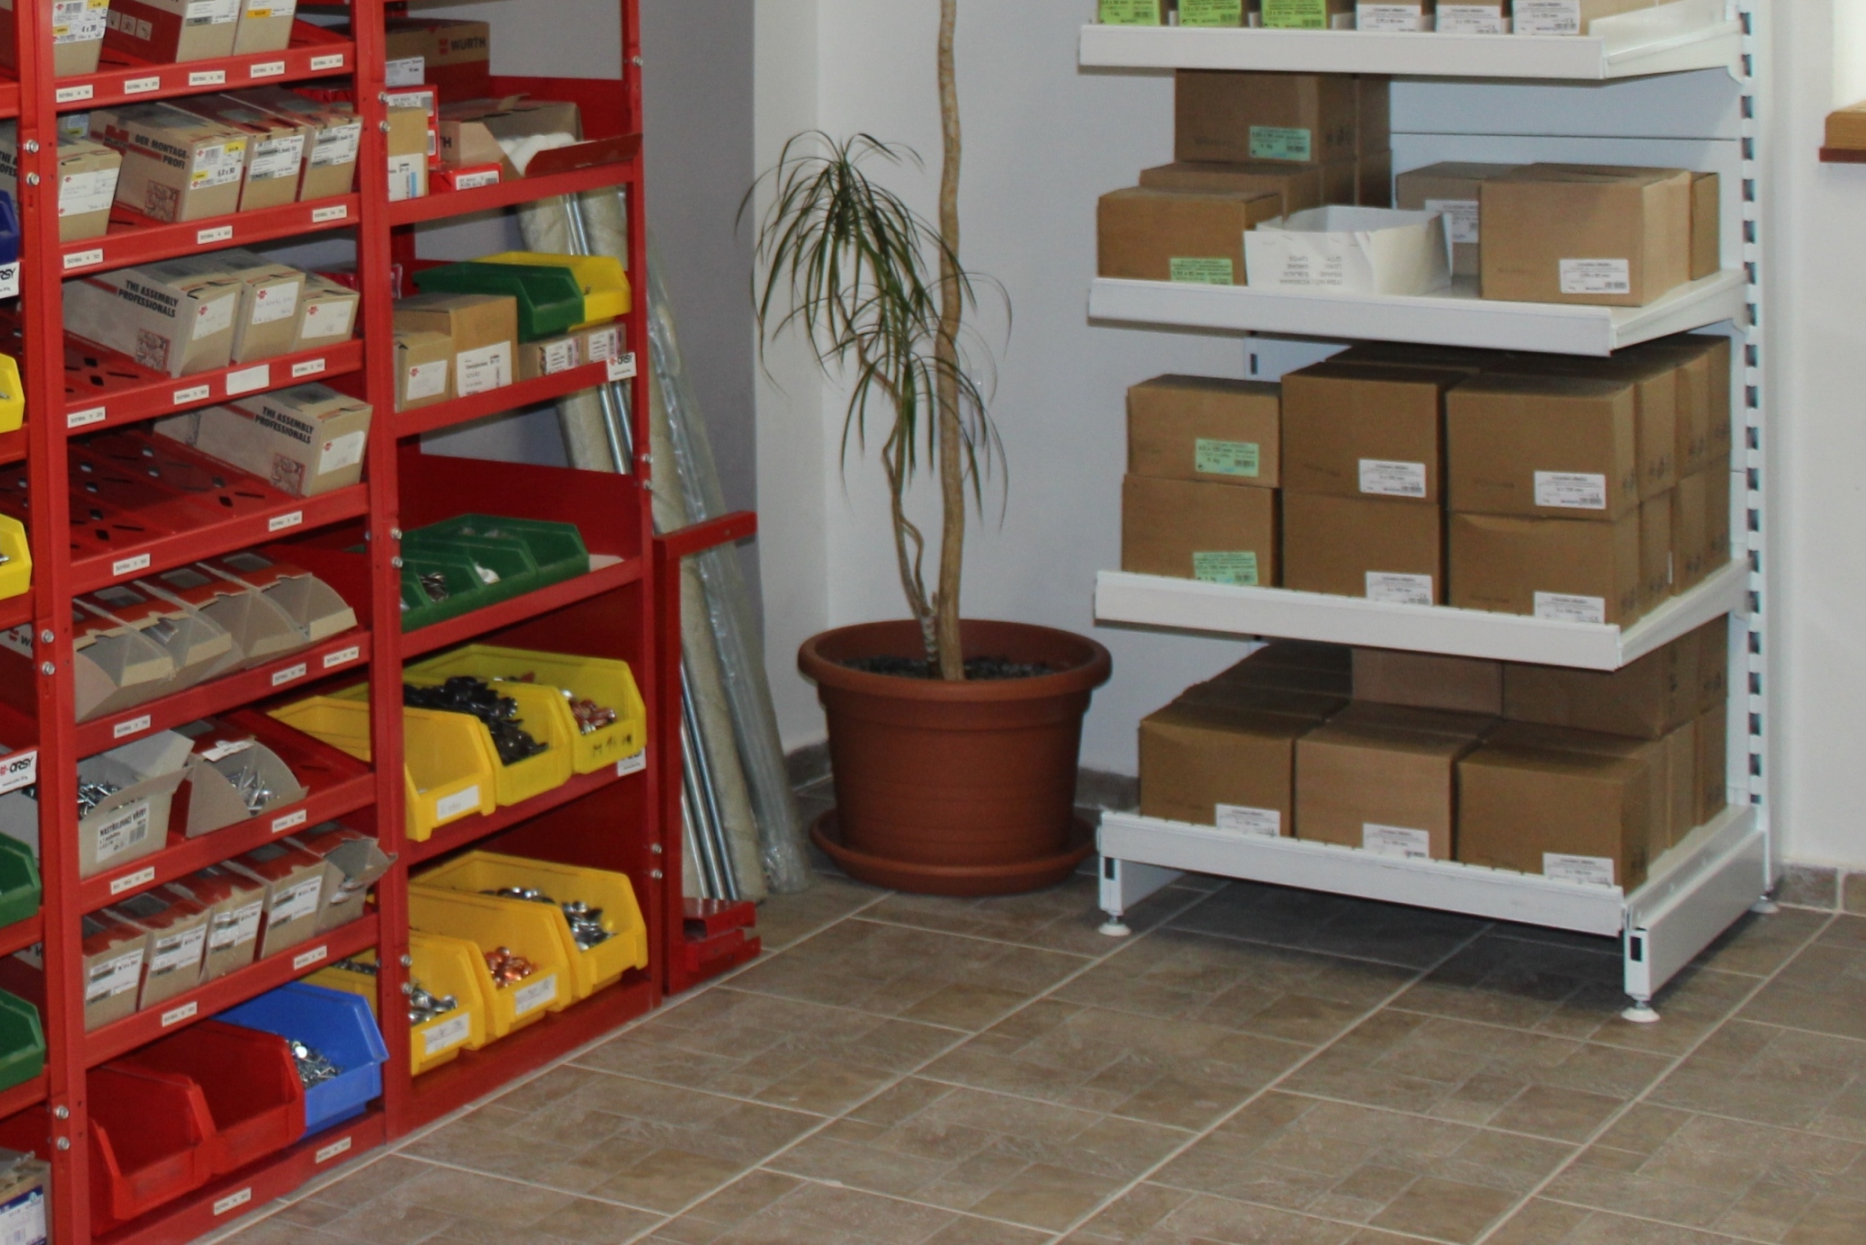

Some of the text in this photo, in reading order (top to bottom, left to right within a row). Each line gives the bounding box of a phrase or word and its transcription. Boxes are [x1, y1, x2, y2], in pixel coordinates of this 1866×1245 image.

[134, 134, 149, 145] DER
[163, 154, 186, 170] PROFI
[118, 287, 176, 316] PROFESSIONALS
[125, 279, 179, 307] THE ASSEMBLY
[254, 414, 313, 446] PROFESSIONALS
[281, 411, 315, 436] ASSEMBLY
[9, 756, 34, 774] ORSY
